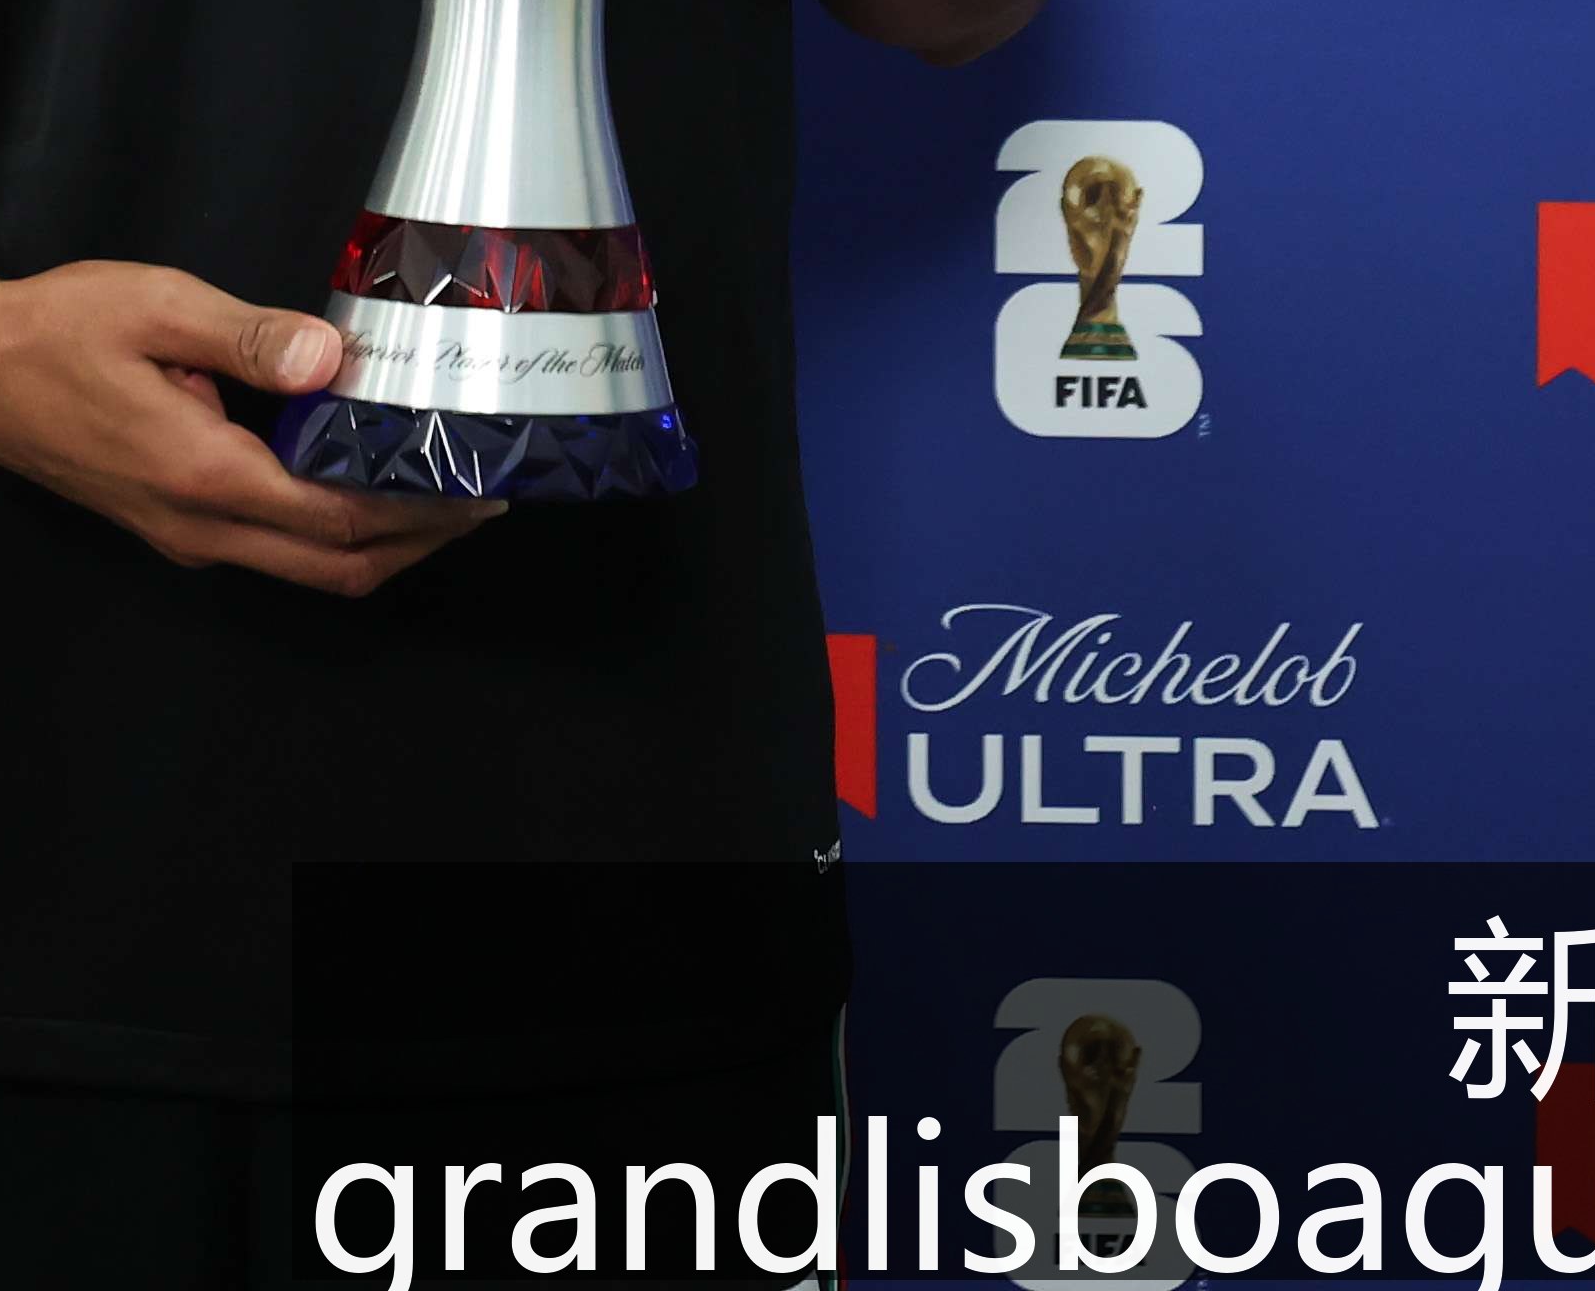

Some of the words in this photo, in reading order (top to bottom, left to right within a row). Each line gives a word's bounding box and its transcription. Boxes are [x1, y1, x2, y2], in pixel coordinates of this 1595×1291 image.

[540, 349, 579, 375] the
[1055, 375, 1147, 409] FIFA
[902, 604, 1363, 711] Michelob
[908, 733, 1379, 828] ULTRA
